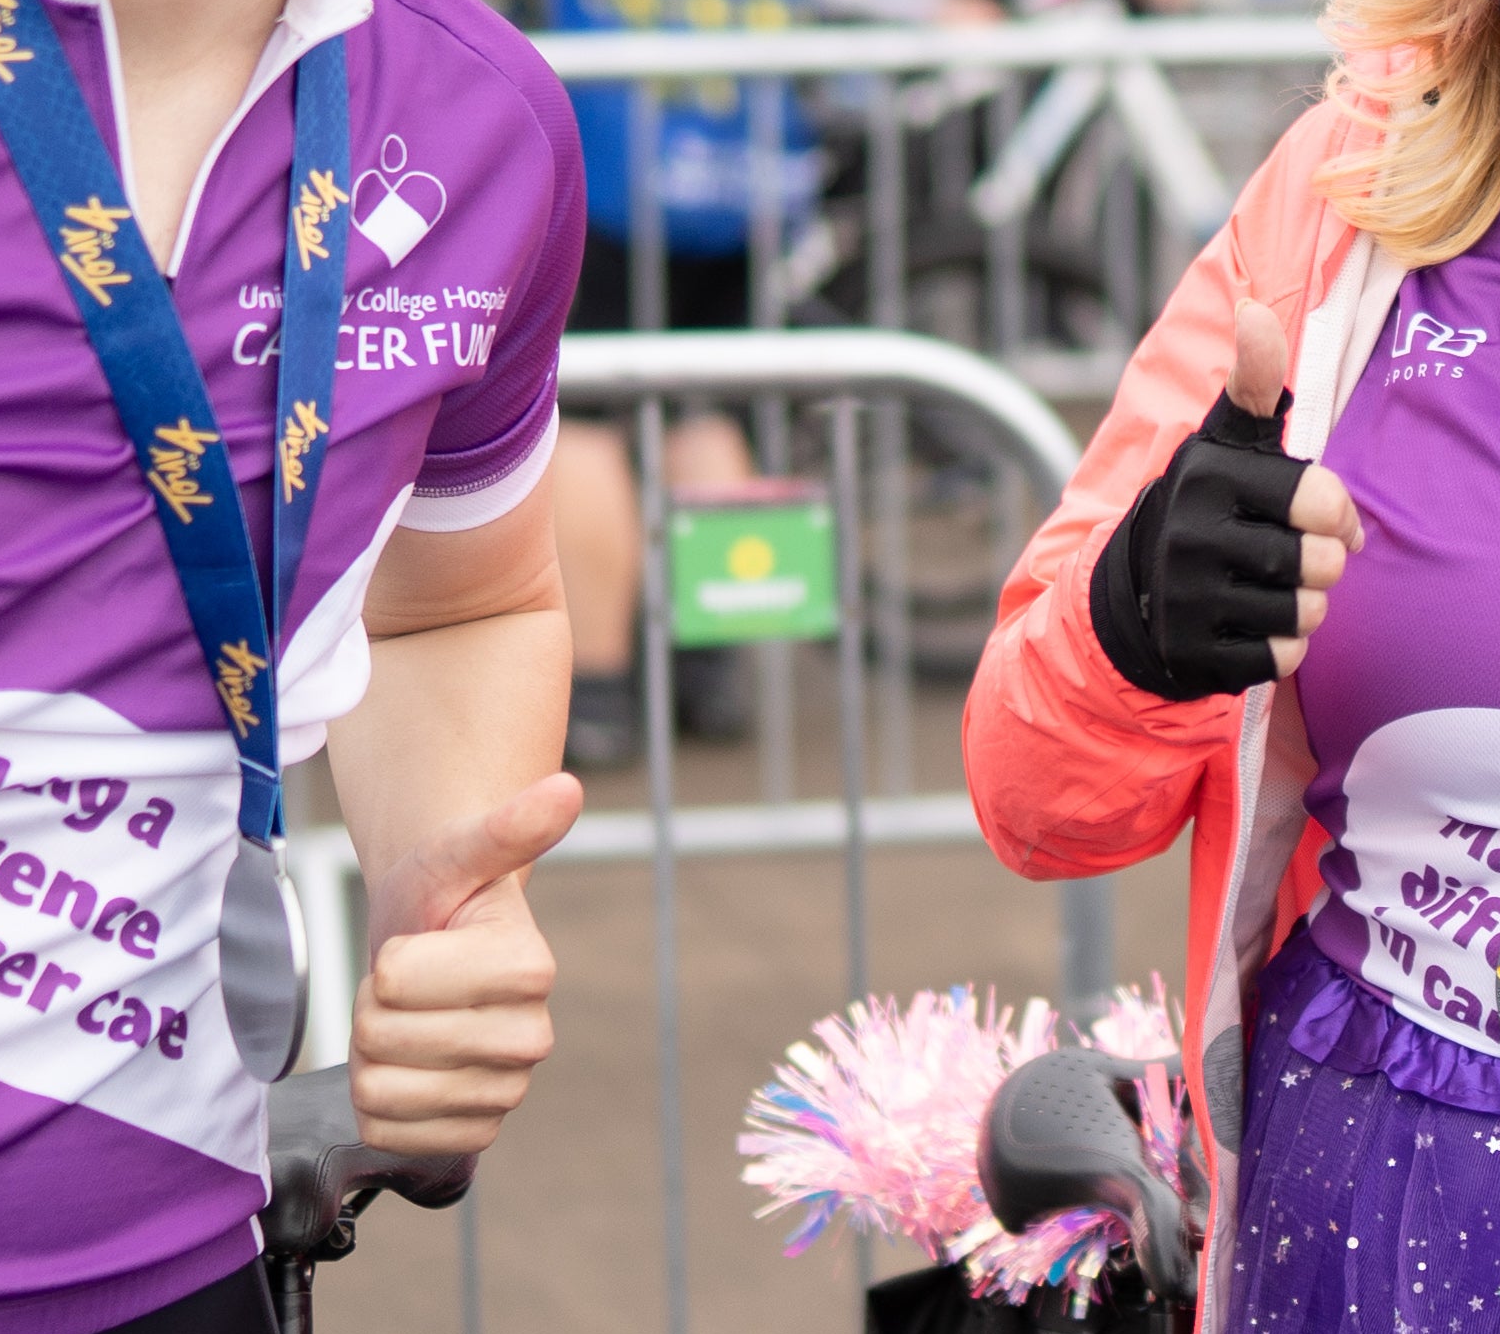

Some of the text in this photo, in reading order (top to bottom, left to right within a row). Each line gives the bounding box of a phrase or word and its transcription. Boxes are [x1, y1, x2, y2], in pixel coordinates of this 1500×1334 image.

[357, 287, 437, 321] College
[232, 322, 417, 370] CACER
[127, 796, 175, 850] a
